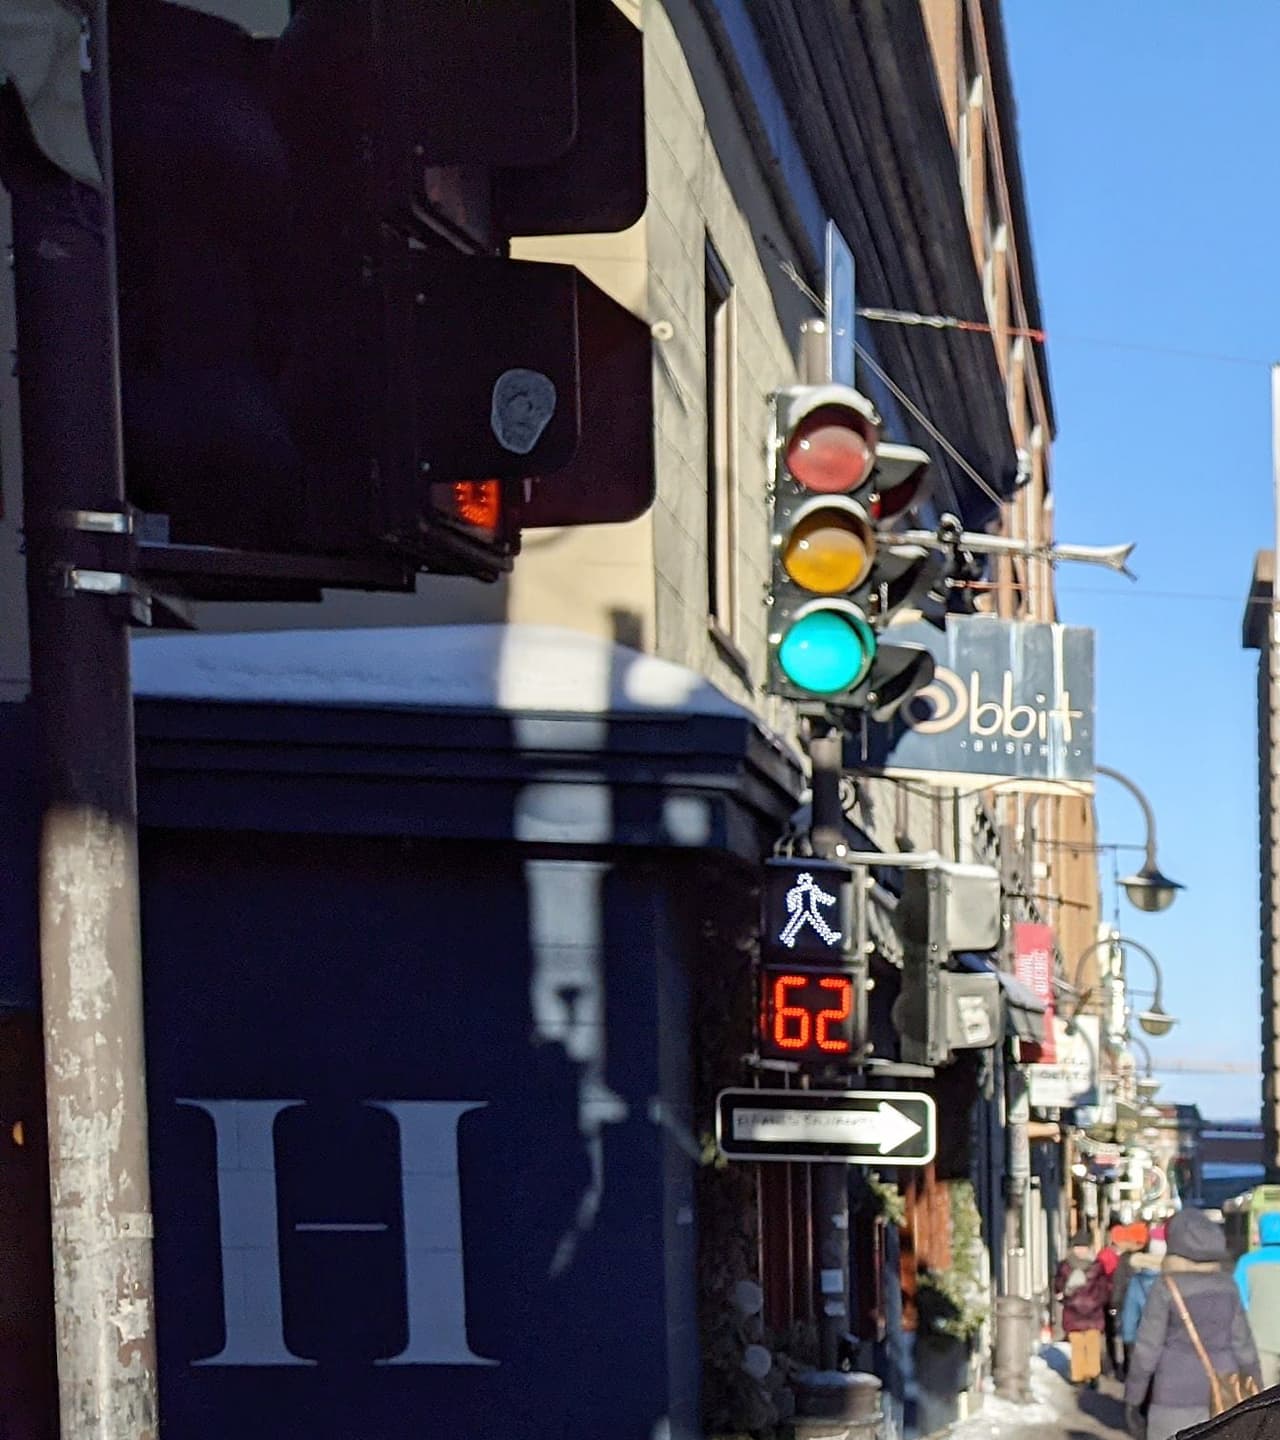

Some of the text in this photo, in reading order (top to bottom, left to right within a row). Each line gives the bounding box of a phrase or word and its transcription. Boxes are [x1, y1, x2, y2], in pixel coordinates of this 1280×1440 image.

[901, 665, 1083, 742] Obbit
[775, 976, 850, 1049] 62
[175, 1099, 501, 1366] H
